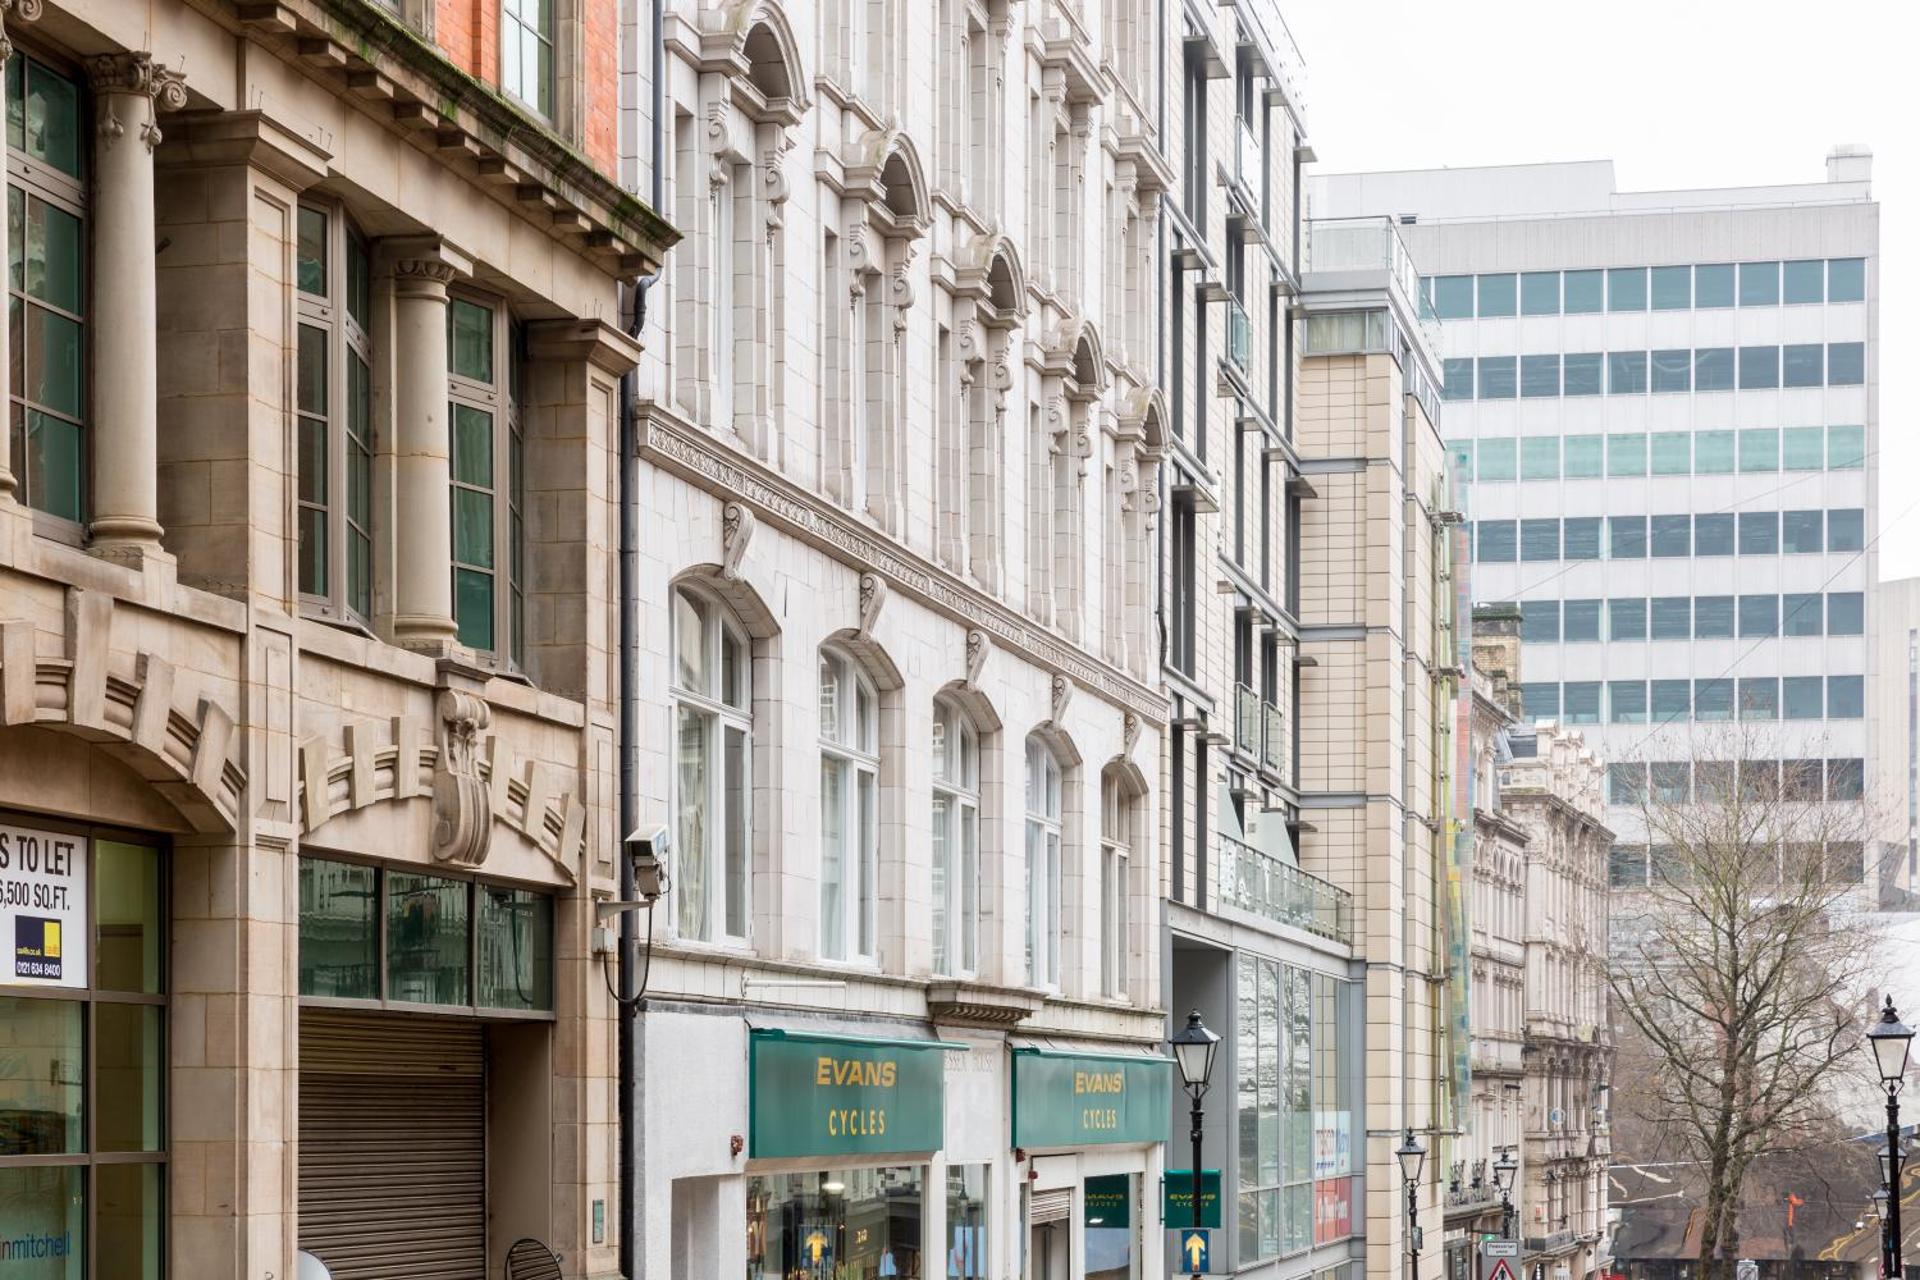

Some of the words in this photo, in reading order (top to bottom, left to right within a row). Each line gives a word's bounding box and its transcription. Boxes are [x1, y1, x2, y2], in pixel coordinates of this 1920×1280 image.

[16, 835, 38, 872] TO
[45, 839, 75, 876] LET
[817, 1057, 896, 1087] EVANS
[1075, 1072, 1122, 1093] EVANS
[829, 1109, 885, 1136] CYCLES
[1083, 1109, 1116, 1129] CYCLES
